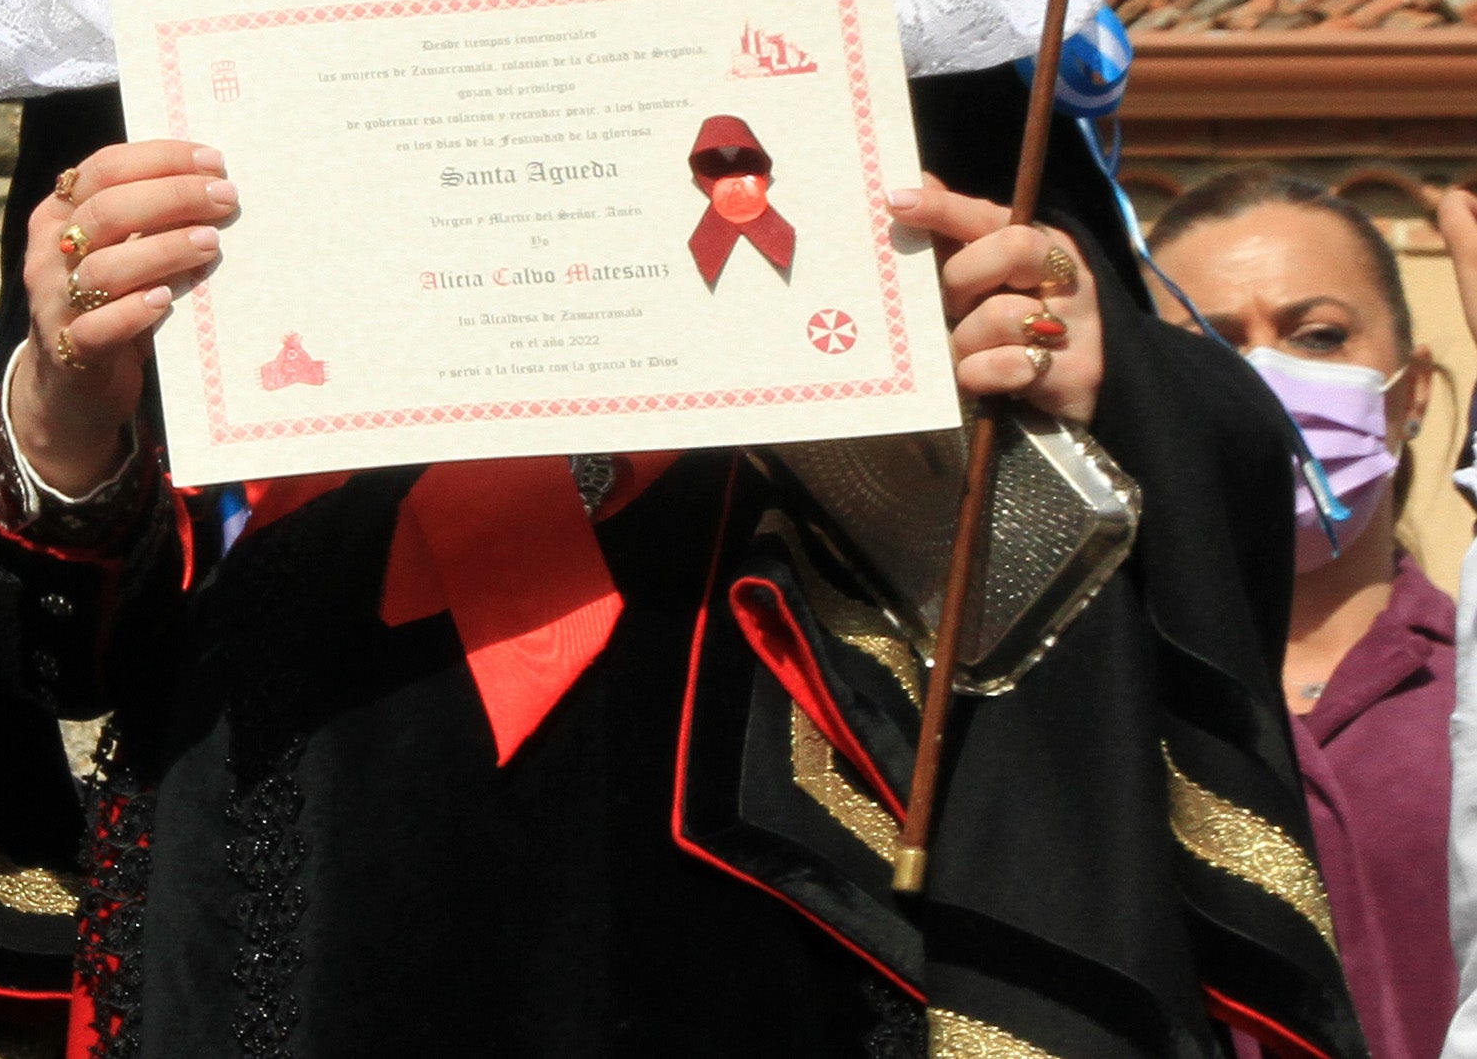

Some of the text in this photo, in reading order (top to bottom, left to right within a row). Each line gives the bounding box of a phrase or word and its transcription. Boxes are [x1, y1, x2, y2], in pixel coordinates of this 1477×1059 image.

[421, 29, 597, 51] Desde tiempos inmemoriales
[318, 73, 336, 82] las
[341, 70, 389, 81] mujeres
[393, 68, 406, 77] de
[553, 57, 566, 67] de
[570, 56, 581, 65] la
[586, 52, 630, 64] Ciudad
[633, 51, 646, 60] de
[496, 85, 513, 96] del
[517, 83, 575, 96] privilegio
[346, 120, 360, 130] de
[364, 118, 418, 131] gobernar
[423, 116, 443, 125] esa
[604, 105, 611, 113] a
[615, 103, 634, 113] los
[396, 143, 410, 151] en
[414, 141, 432, 150] los
[465, 138, 479, 147] de
[483, 137, 494, 147] la
[499, 133, 565, 148] Festividad
[569, 132, 581, 141] de
[586, 130, 597, 140] la
[602, 128, 652, 141] gloriosa
[439, 160, 619, 188] Santa Agueda
[429, 216, 473, 228] Virgen
[535, 211, 553, 221] del
[531, 236, 549, 249] Yo
[419, 263, 670, 290] Alicia Calvo Matesanz
[458, 307, 643, 326] fui Alcaldesa de Zamarramala
[510, 335, 600, 349] en el año 2022
[485, 367, 492, 375] a
[495, 365, 507, 375] la
[511, 364, 544, 374] fiesta
[549, 364, 569, 372] con
[573, 361, 584, 371] la
[588, 361, 626, 373] gracia
[629, 359, 642, 368] de
[647, 356, 678, 368] Dios
